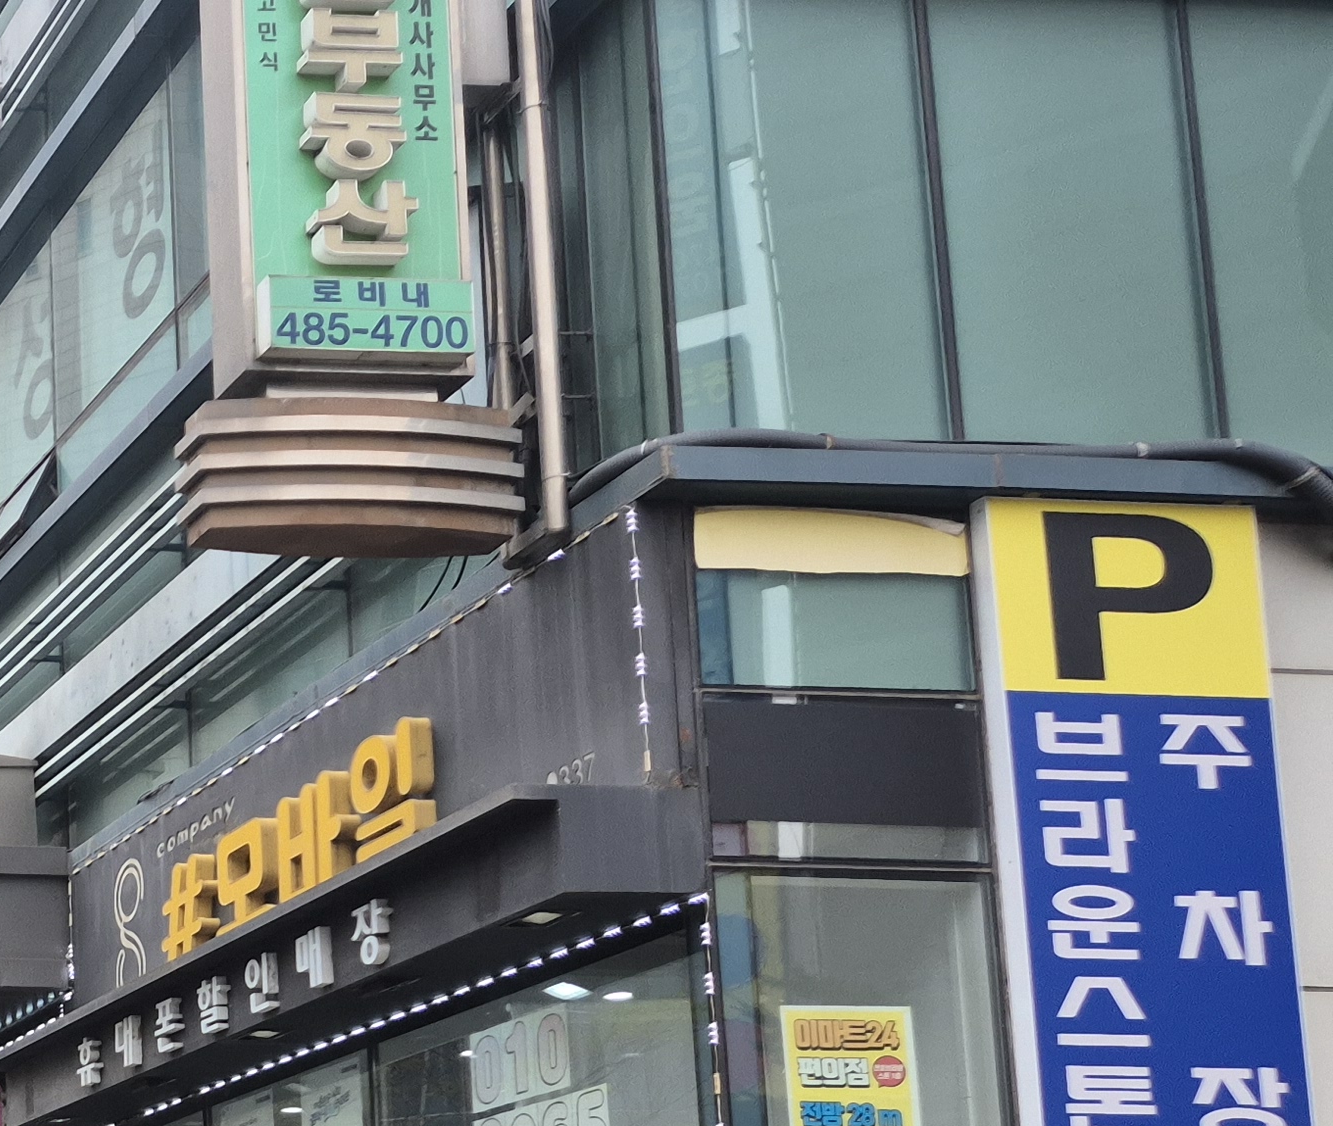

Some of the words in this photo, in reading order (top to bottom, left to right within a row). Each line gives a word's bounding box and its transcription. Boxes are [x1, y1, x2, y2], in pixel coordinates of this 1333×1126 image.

[296, 8, 419, 268] 부동산
[312, 279, 430, 308] 로비내
[275, 310, 470, 349] 485-4700
[1041, 510, 1214, 682] P
[155, 796, 237, 859] company
[162, 715, 436, 962] #모바일
[474, 1012, 571, 1106] 010
[793, 1018, 900, 1051] 이마트24
[797, 1056, 871, 1088] 편의점
